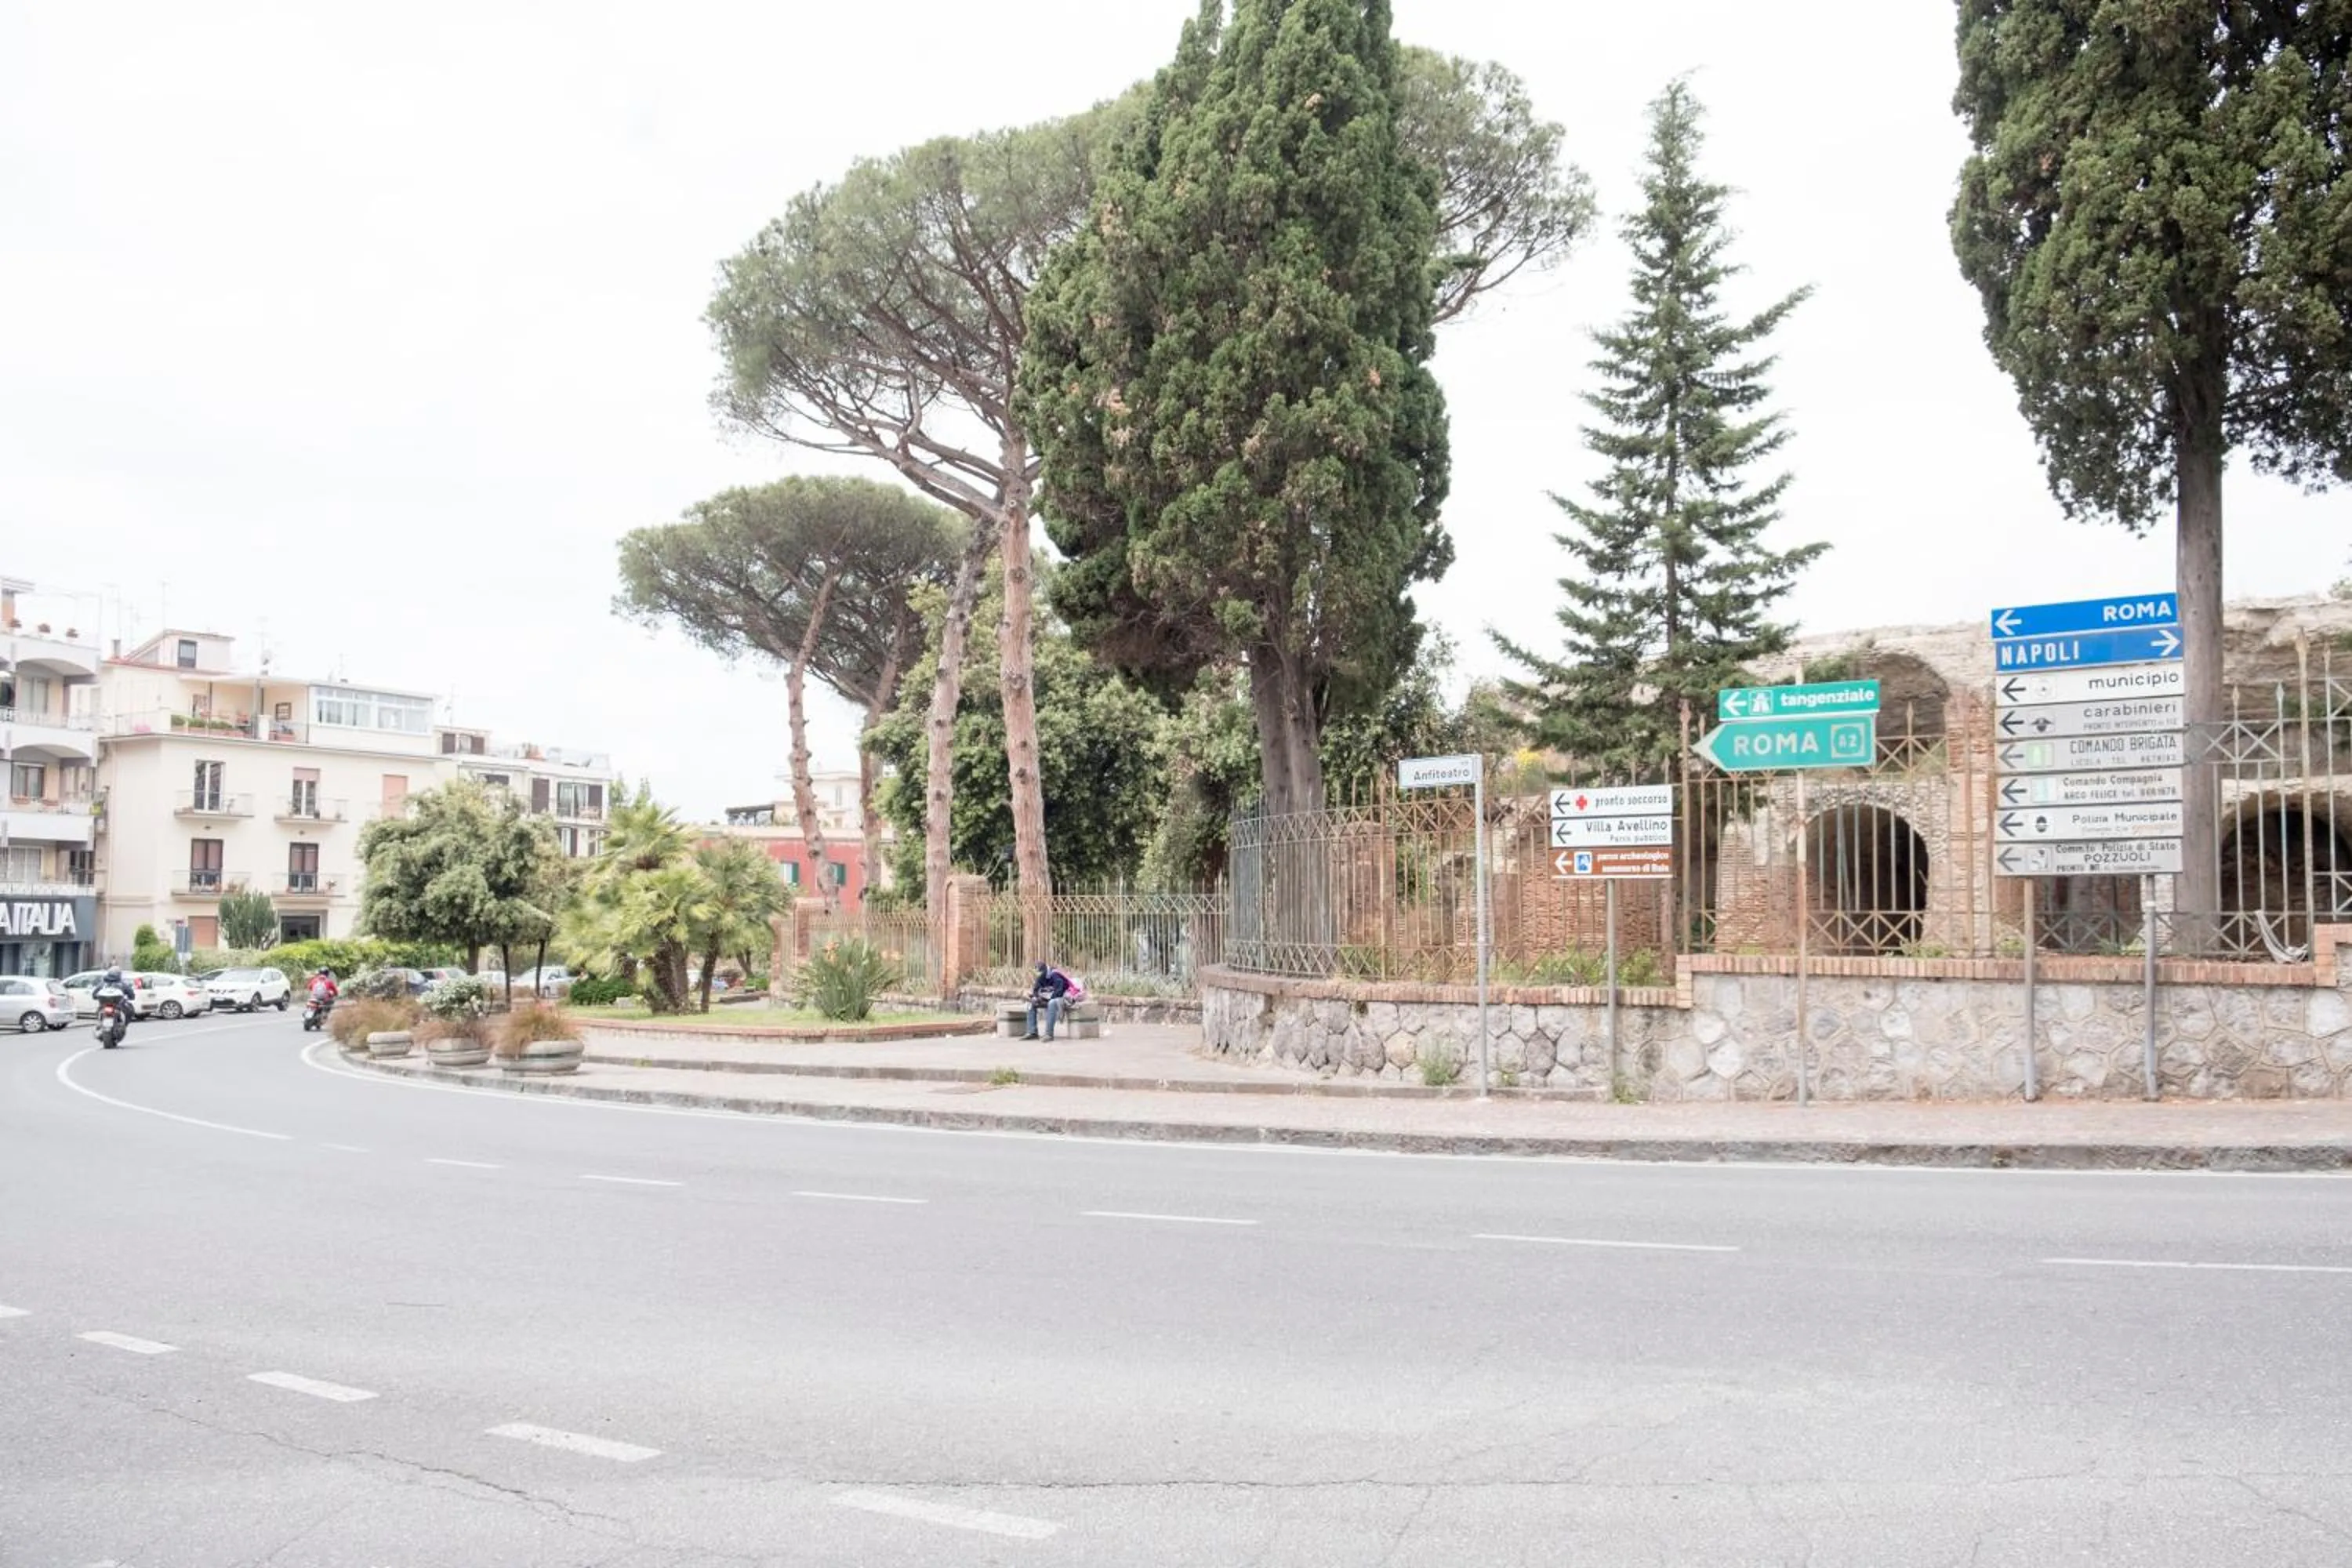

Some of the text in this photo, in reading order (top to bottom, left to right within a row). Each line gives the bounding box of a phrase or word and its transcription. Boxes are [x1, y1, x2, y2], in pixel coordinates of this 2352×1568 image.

[2103, 601, 2172, 622] ROMA
[2002, 641, 2079, 666] NAPOLI
[2089, 671, 2179, 689] municipio
[1780, 688, 1875, 708] tangenziale
[2083, 703, 2176, 717] carabinieri
[1733, 731, 1819, 757] ROMA
[2070, 735, 2176, 753] COMANDO BRIGATA
[1414, 768, 1469, 781] Anfiteatro
[2063, 773, 2163, 786] Comando Compagnia
[1595, 795, 1668, 809] pronto soccorso
[2072, 811, 2177, 823] Polizia Municipale
[1586, 819, 1668, 832] Villa Avellino
[2101, 843, 2132, 852] Polizia
[2149, 841, 2176, 851] Stato
[2084, 852, 2151, 863] POZZUOLI
